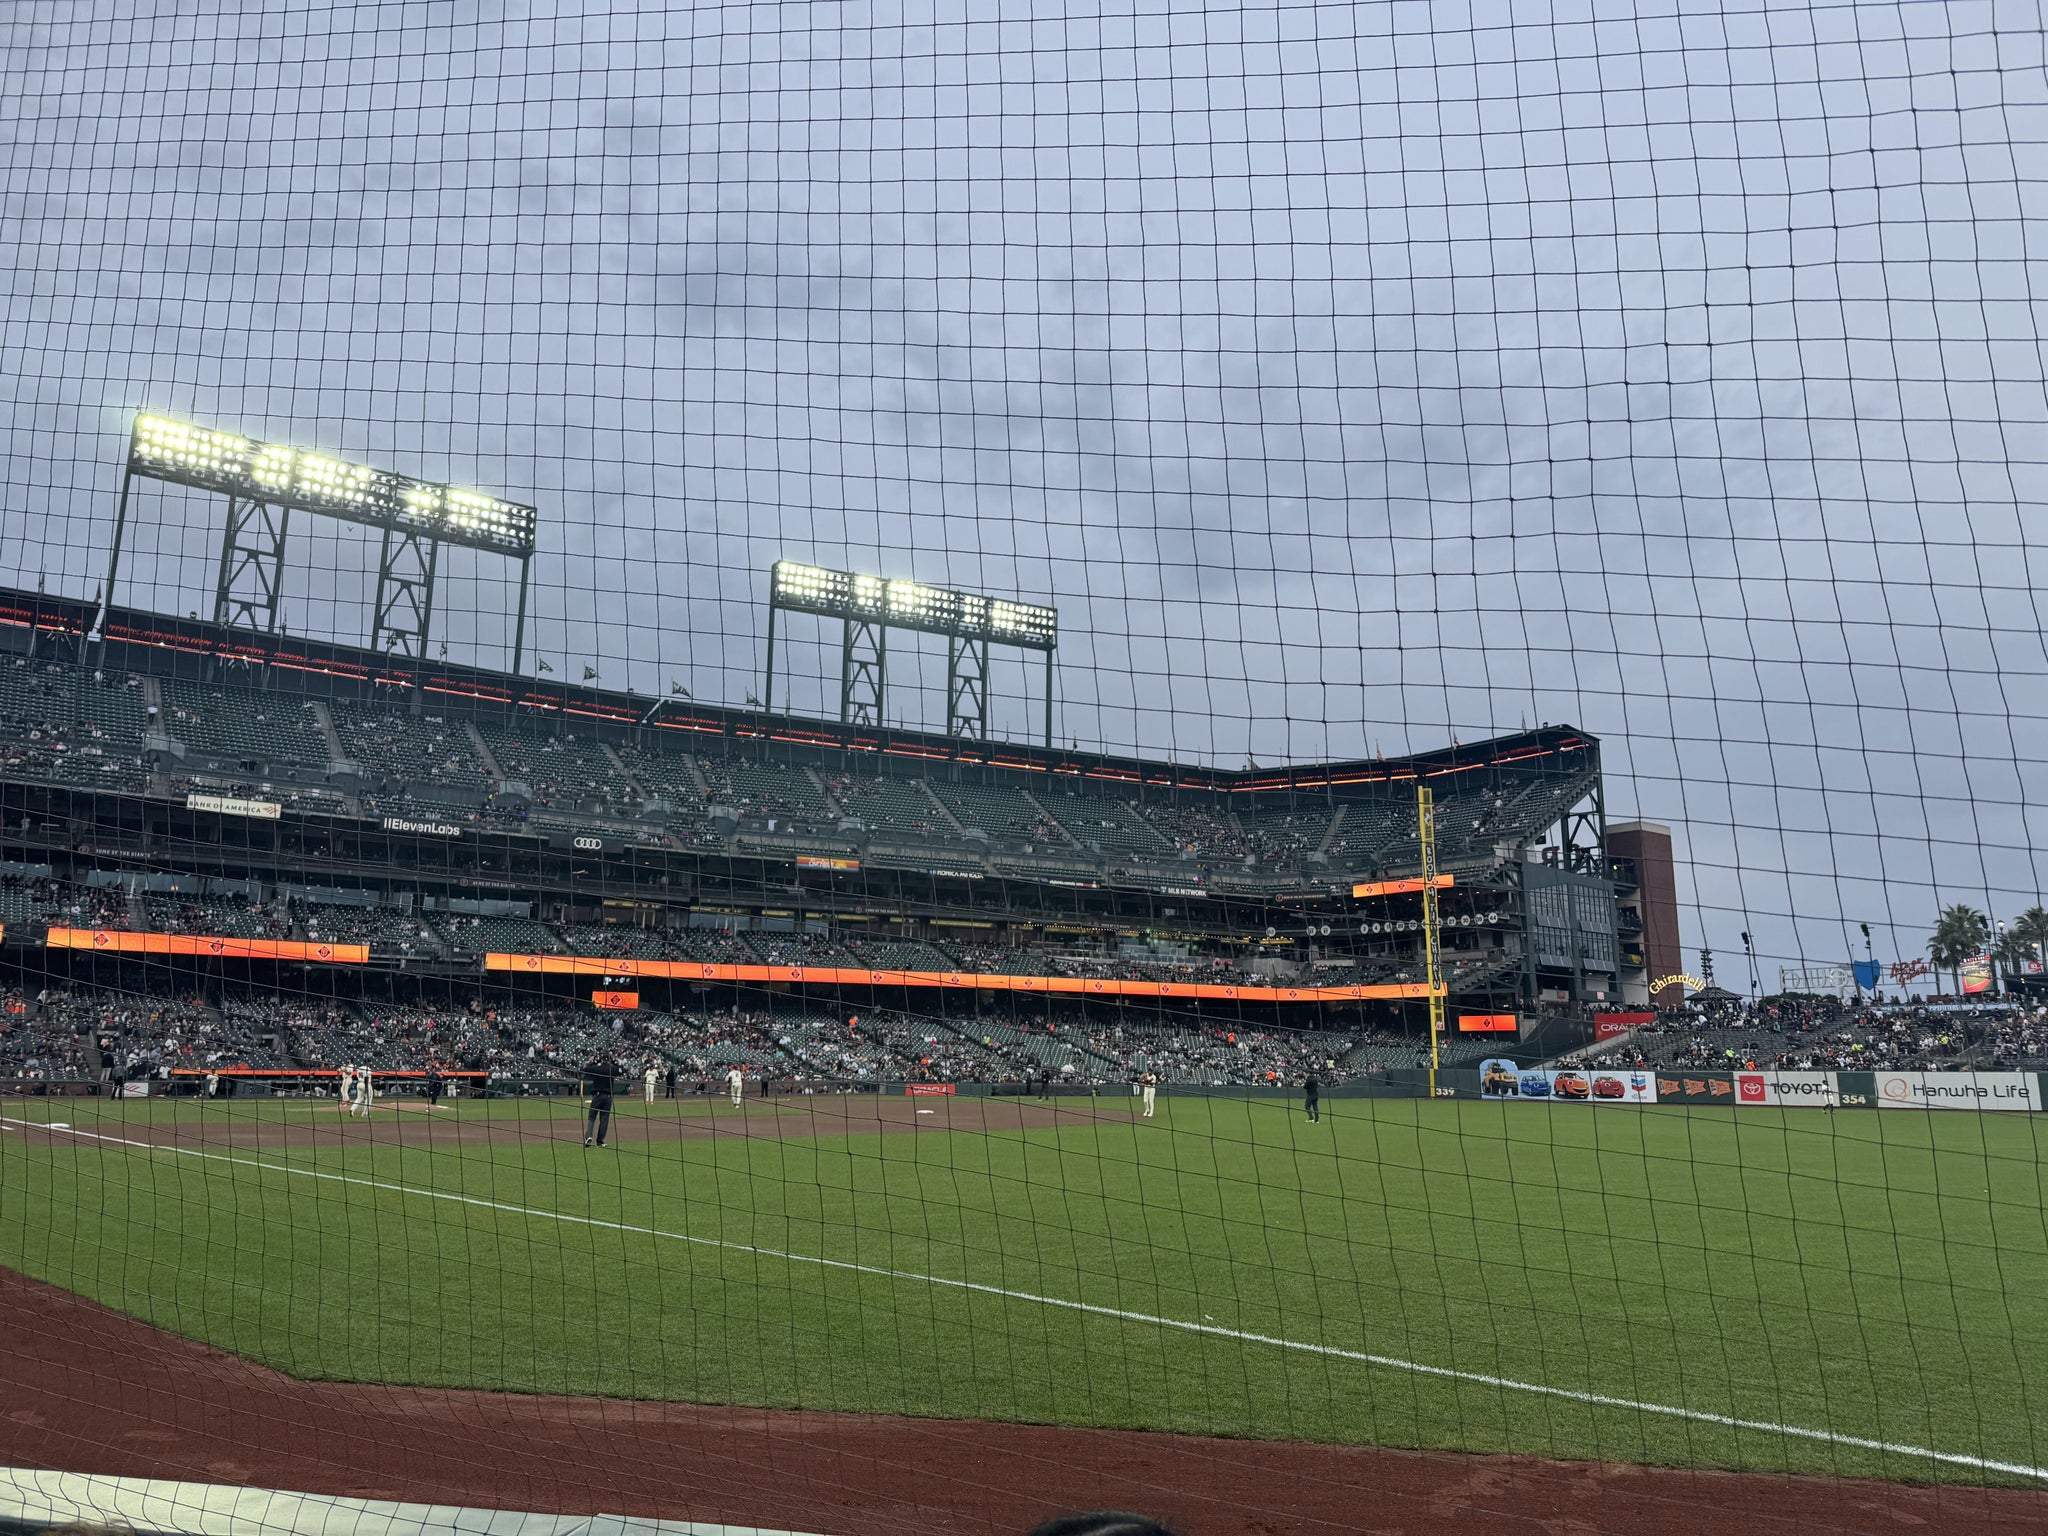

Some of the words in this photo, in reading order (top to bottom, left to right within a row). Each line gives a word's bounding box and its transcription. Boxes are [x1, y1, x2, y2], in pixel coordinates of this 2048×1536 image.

[1649, 972, 1706, 995] Ghirardelli
[1770, 1082, 1824, 1095] TOYOT
[1912, 1084, 1988, 1098] Hanwha
[1993, 1084, 2030, 1098] Life
[1842, 1094, 1867, 1104] 354
